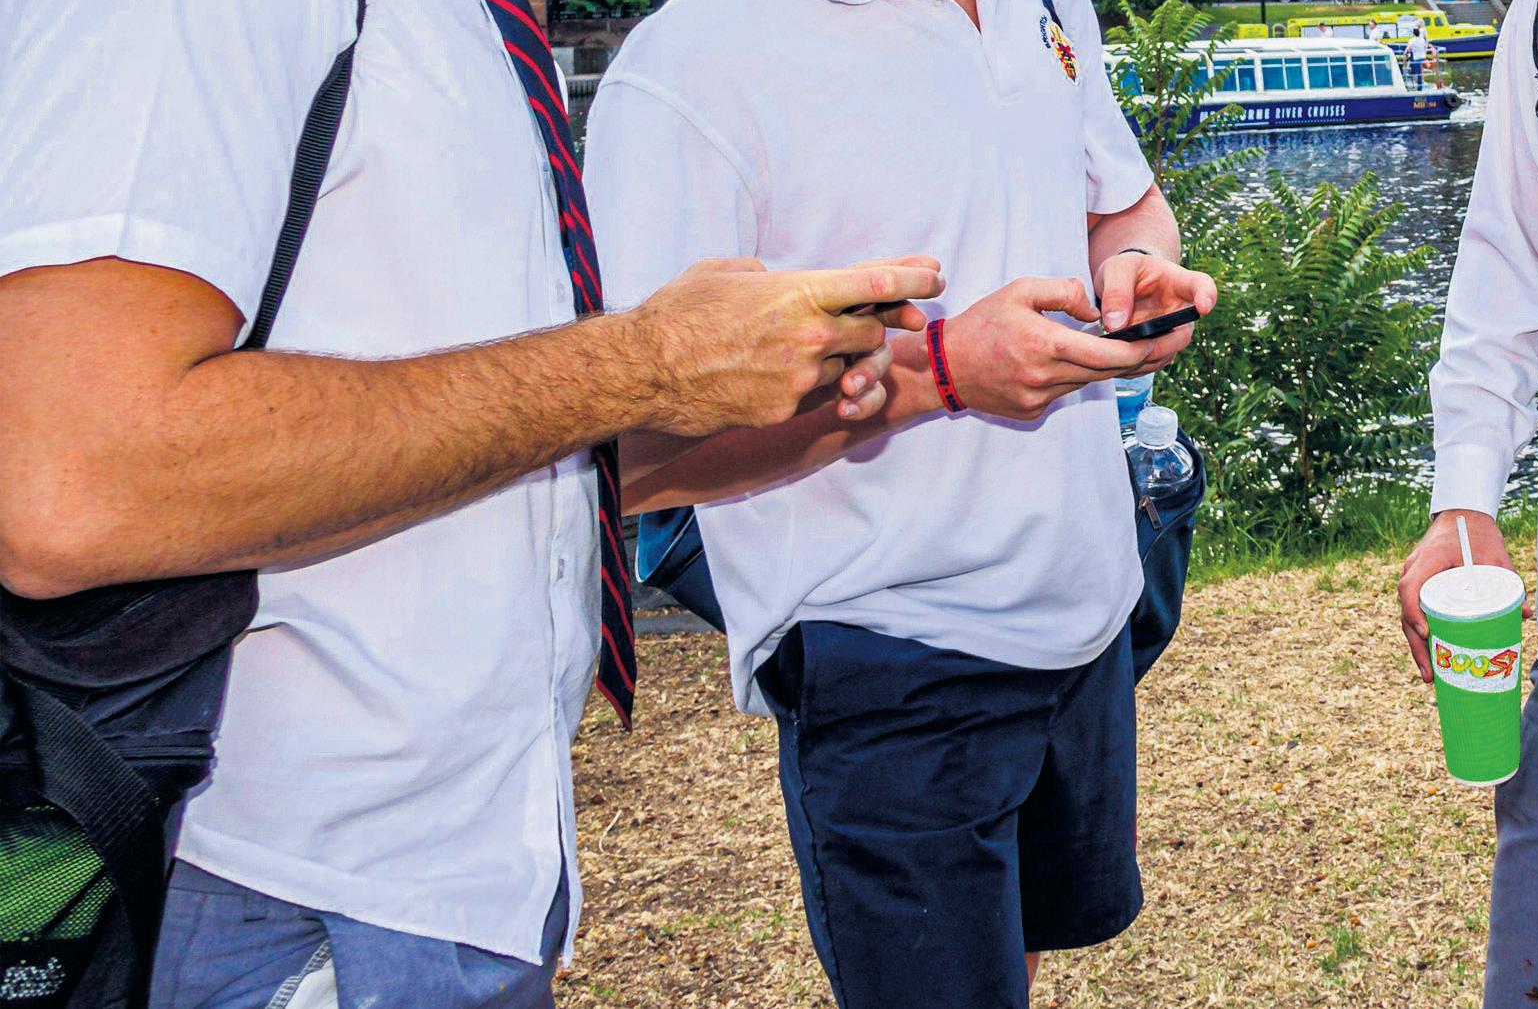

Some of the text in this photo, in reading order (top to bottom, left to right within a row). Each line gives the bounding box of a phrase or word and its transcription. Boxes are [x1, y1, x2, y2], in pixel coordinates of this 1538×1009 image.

[1275, 106, 1303, 120] RIVER
[1307, 104, 1346, 118] CRUISES
[1435, 642, 1519, 679] BOOST
